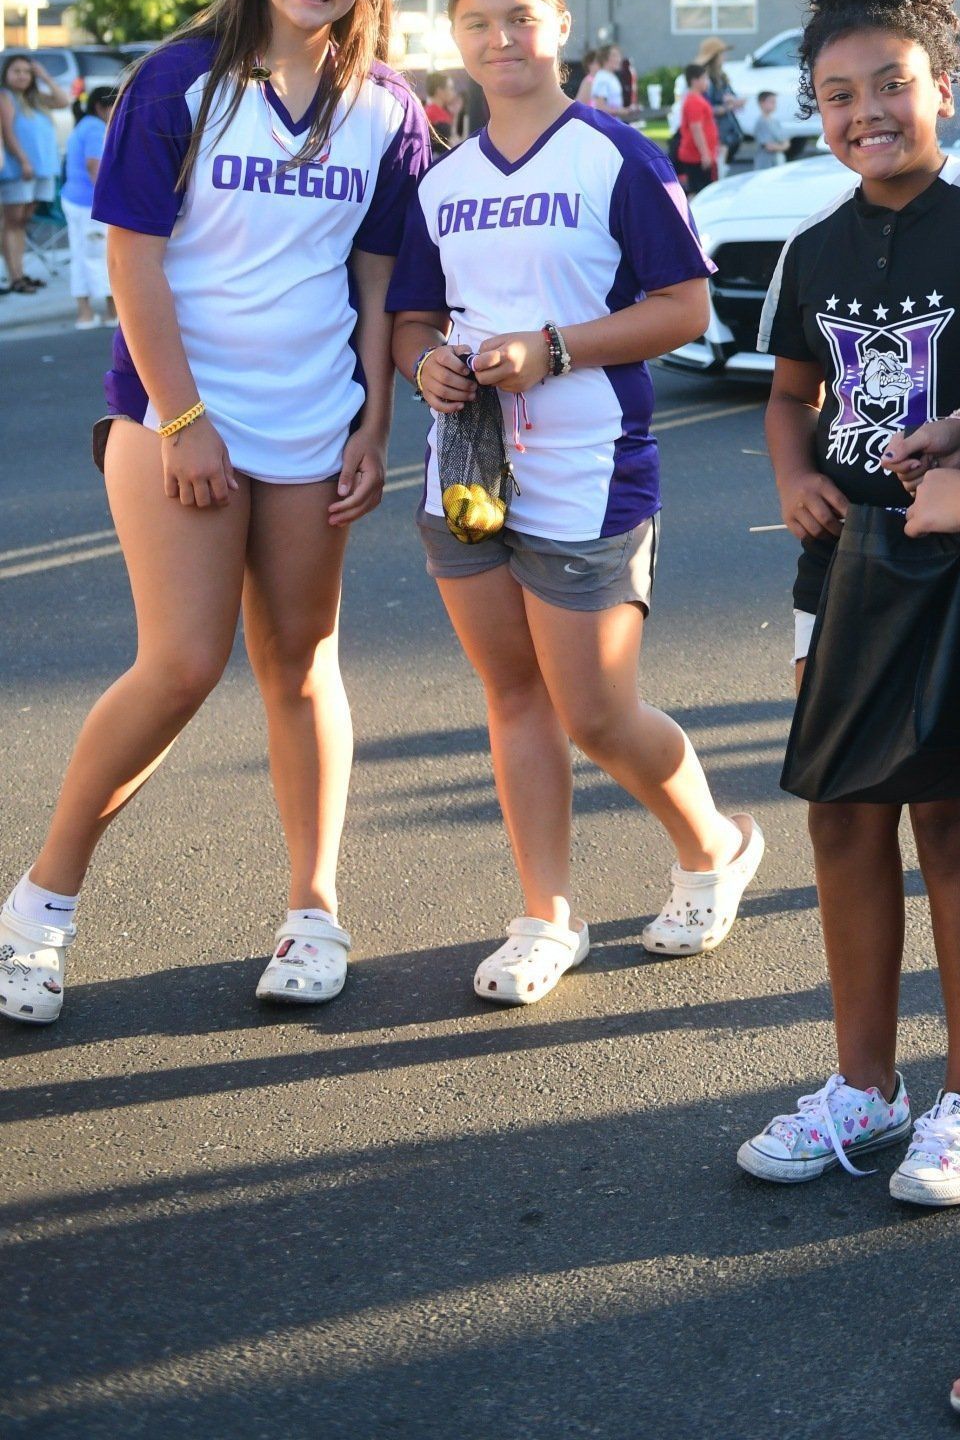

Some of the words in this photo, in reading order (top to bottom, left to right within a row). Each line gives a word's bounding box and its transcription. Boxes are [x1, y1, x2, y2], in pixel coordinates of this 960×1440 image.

[211, 154, 369, 203] OREGON
[437, 192, 581, 238] OREGON
[685, 908, 699, 926] K
